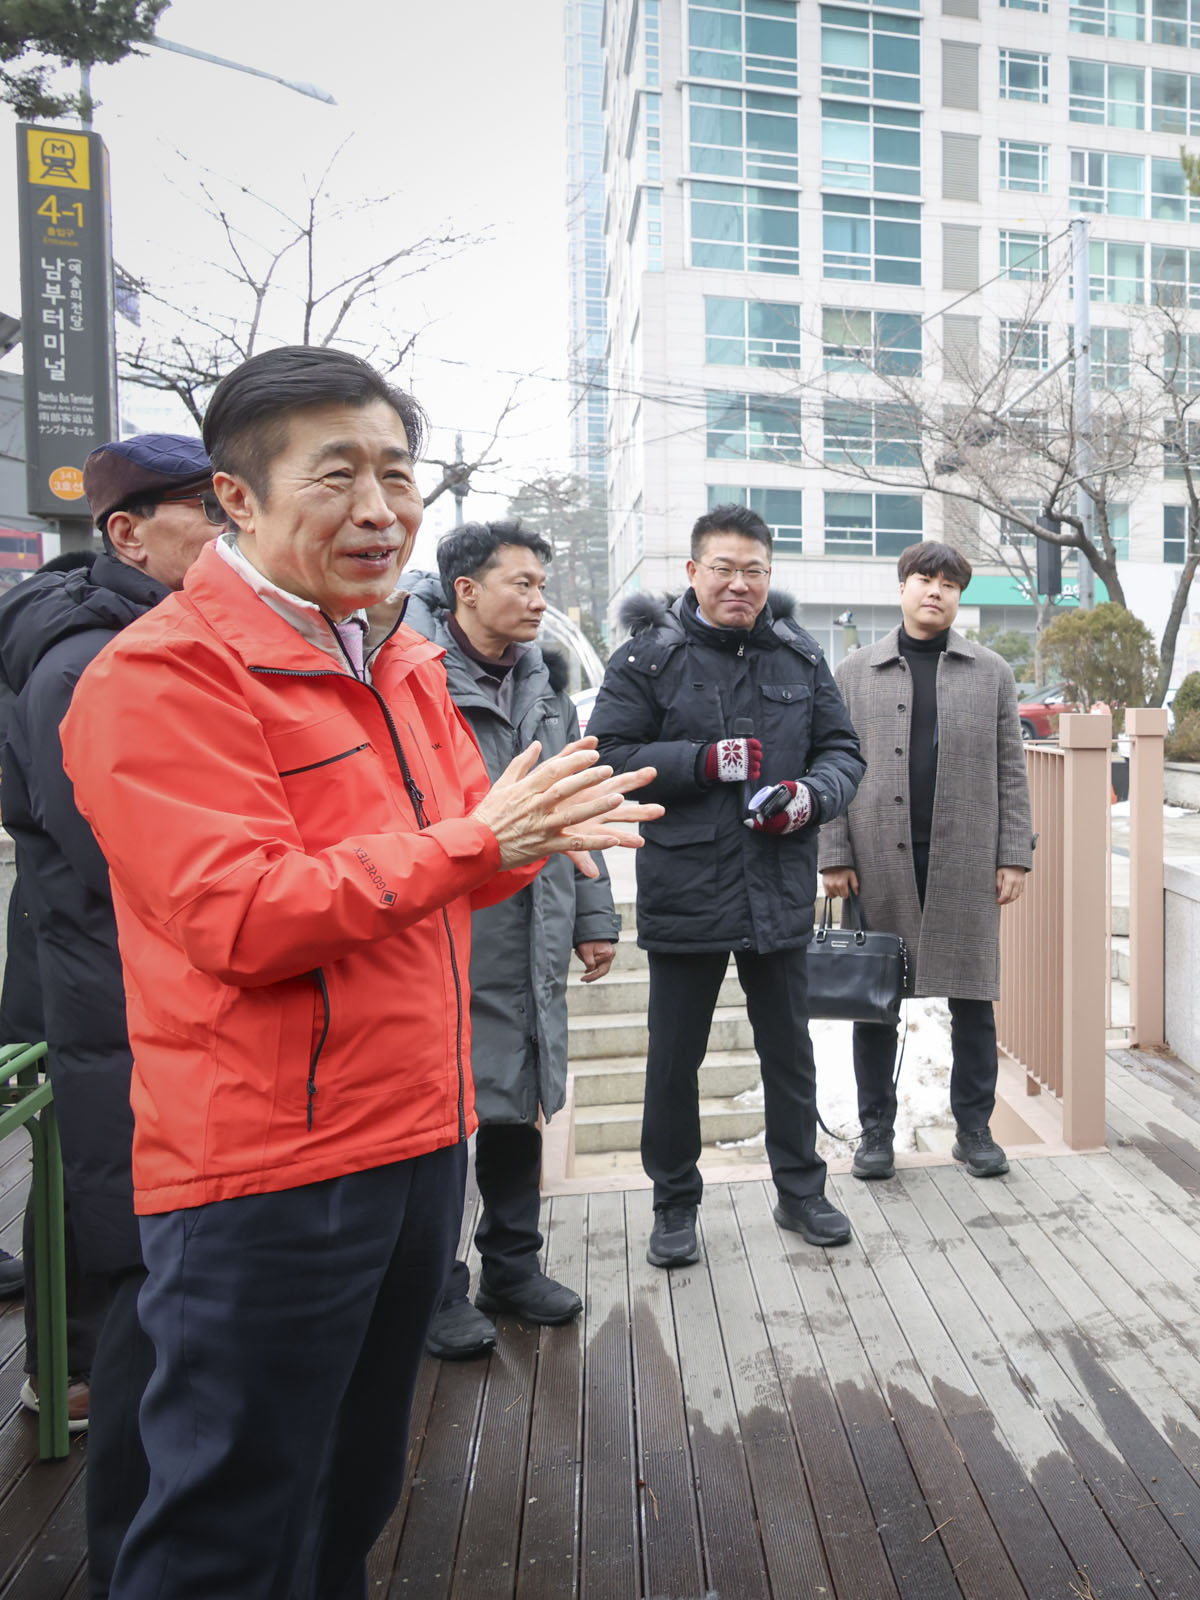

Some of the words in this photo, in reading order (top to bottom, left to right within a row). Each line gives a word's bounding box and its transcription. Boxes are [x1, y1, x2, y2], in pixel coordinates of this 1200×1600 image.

[37, 195, 84, 228] 4-1
[41, 257, 66, 381] 남부터미널
[67, 258, 84, 331] (예술의전당)
[355, 847, 386, 890] GORE-TEX
